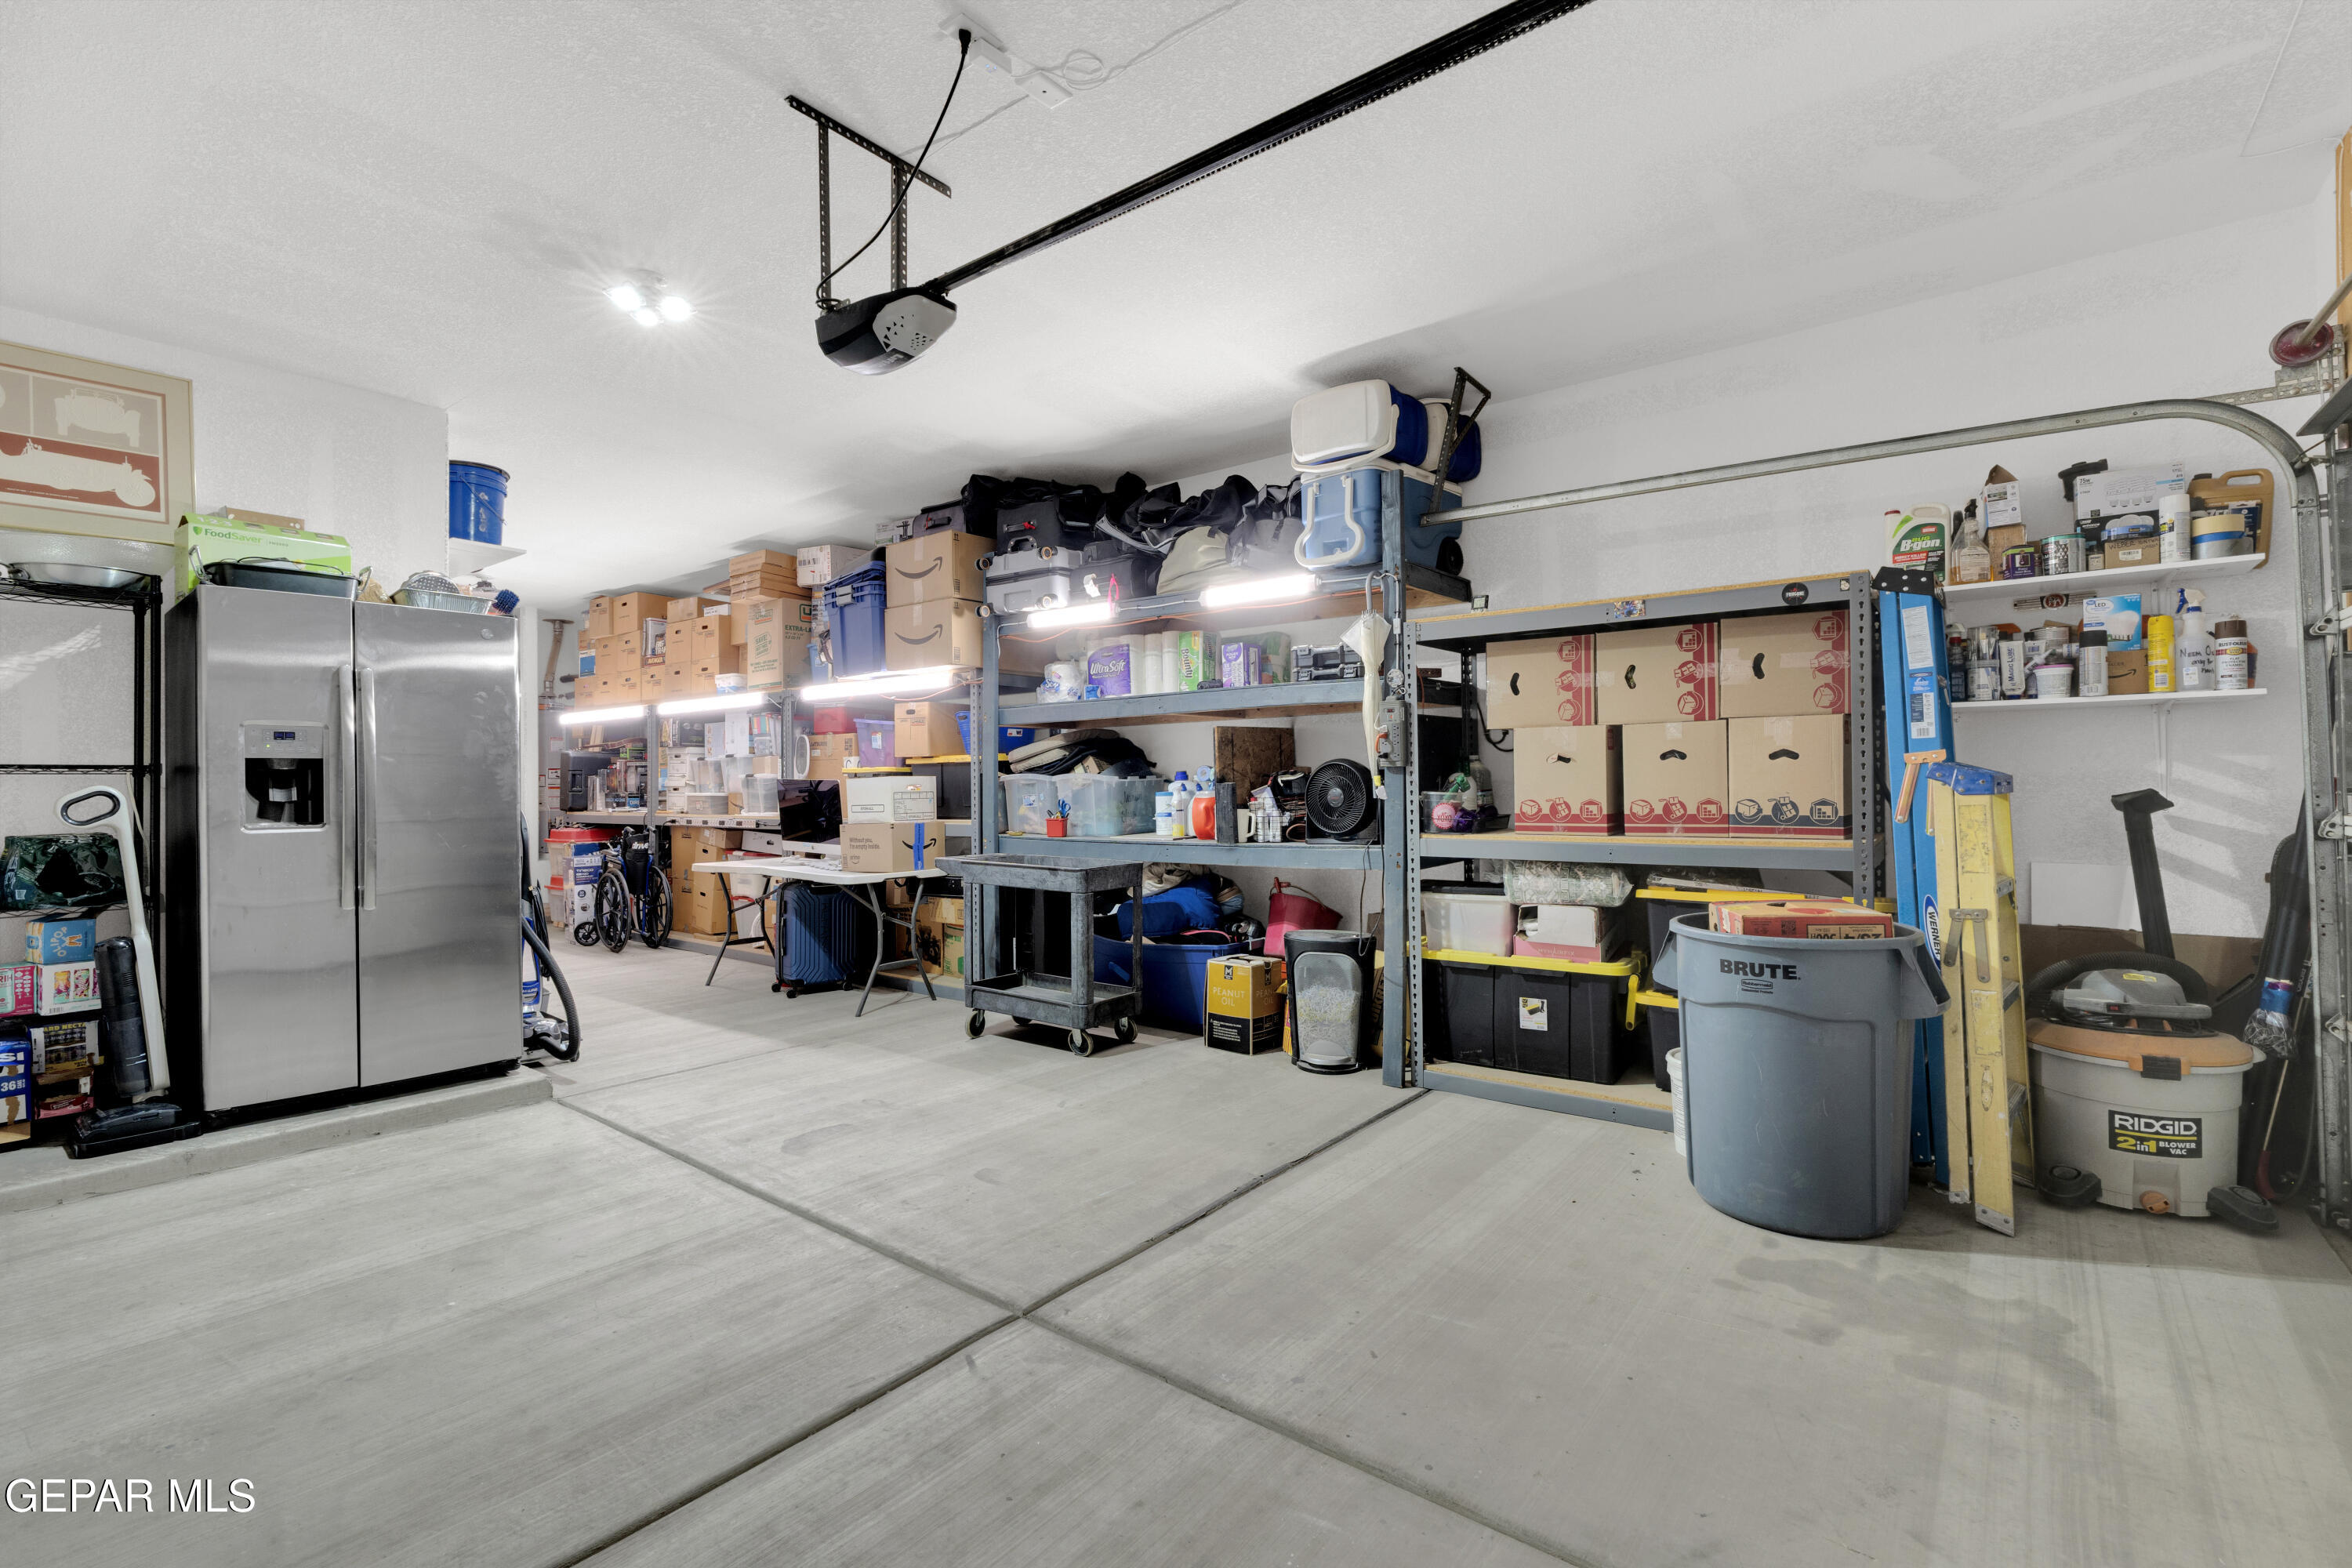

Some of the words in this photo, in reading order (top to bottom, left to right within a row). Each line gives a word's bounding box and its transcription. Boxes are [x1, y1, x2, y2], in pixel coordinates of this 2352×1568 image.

[204, 528, 263, 544] FoodSaver
[1181, 648, 1193, 679] Bounty
[631, 841, 649, 850] drive
[1928, 911, 1941, 955] WERNER
[1719, 958, 1797, 980] BRUTE
[1213, 986, 1246, 998] PEANUT
[1221, 996, 1236, 1007] OIL
[0, 1080, 16, 1092] 36
[2114, 1114, 2197, 1135] RIDGID
